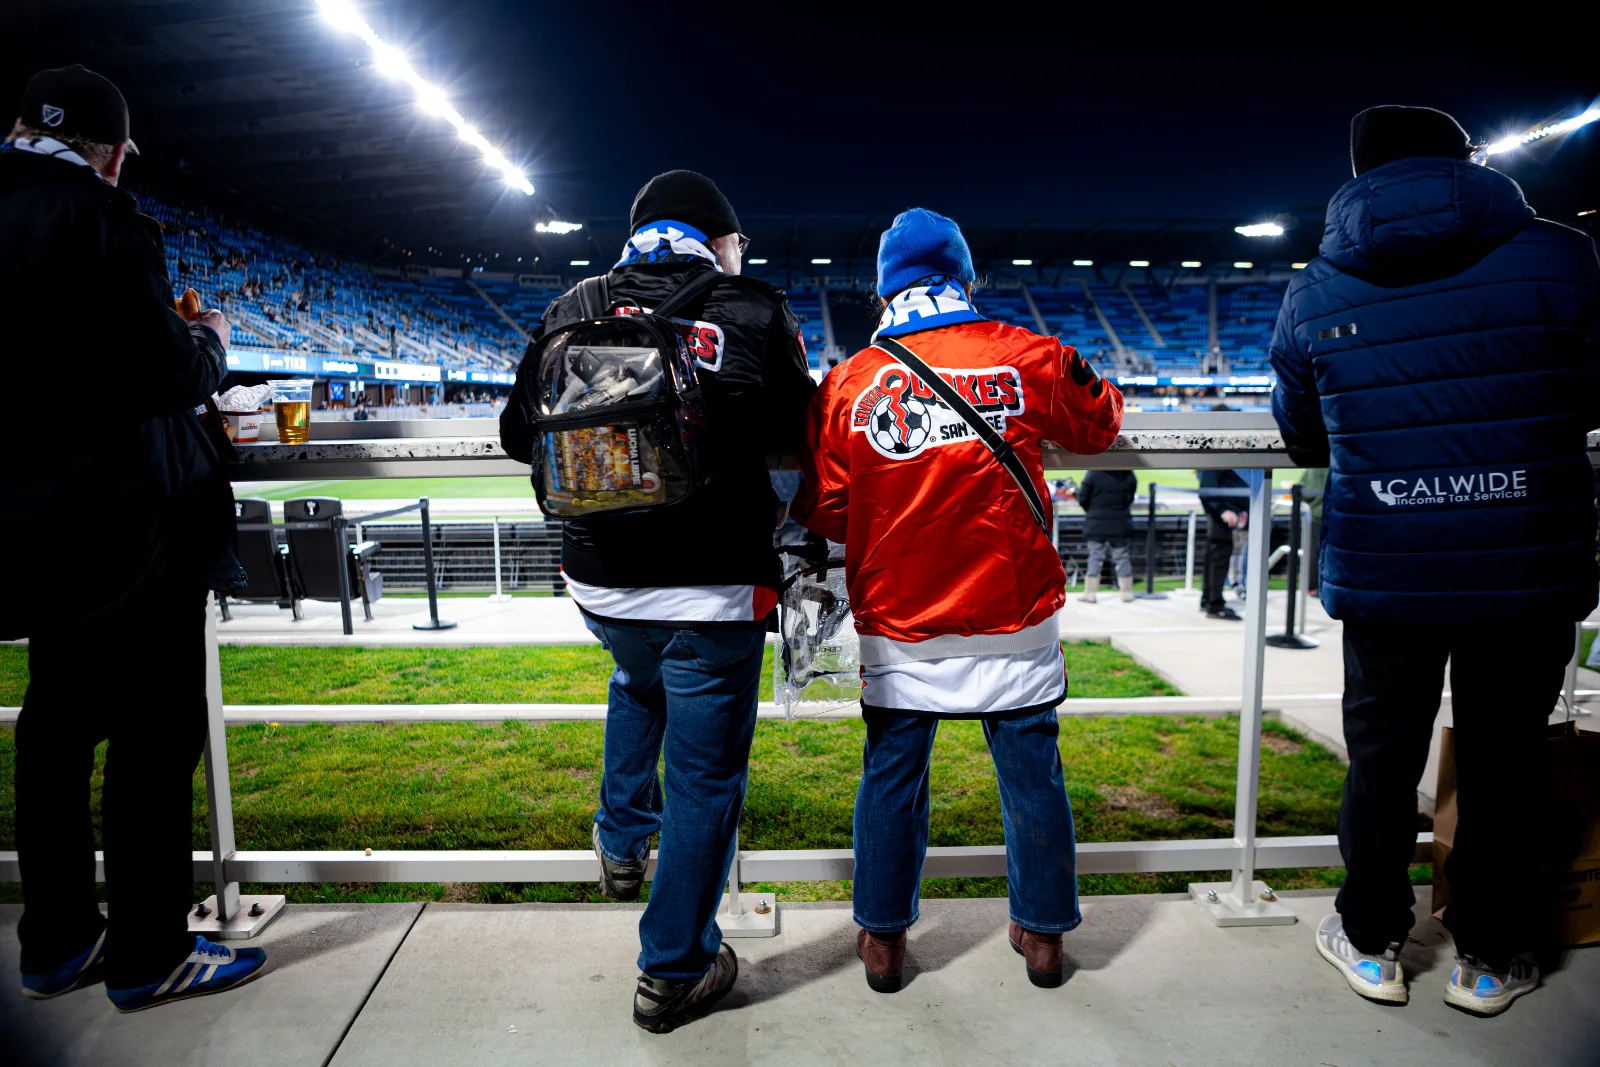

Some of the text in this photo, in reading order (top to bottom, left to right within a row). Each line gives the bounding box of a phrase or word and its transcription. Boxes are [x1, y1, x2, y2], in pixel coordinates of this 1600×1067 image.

[853, 385, 887, 428] EARTH
[940, 424, 968, 440] SAN
[627, 428, 641, 485] LUCHA LIBRE
[1387, 470, 1527, 498] CALWIDE
[1397, 489, 1527, 506] Income Tax Services
